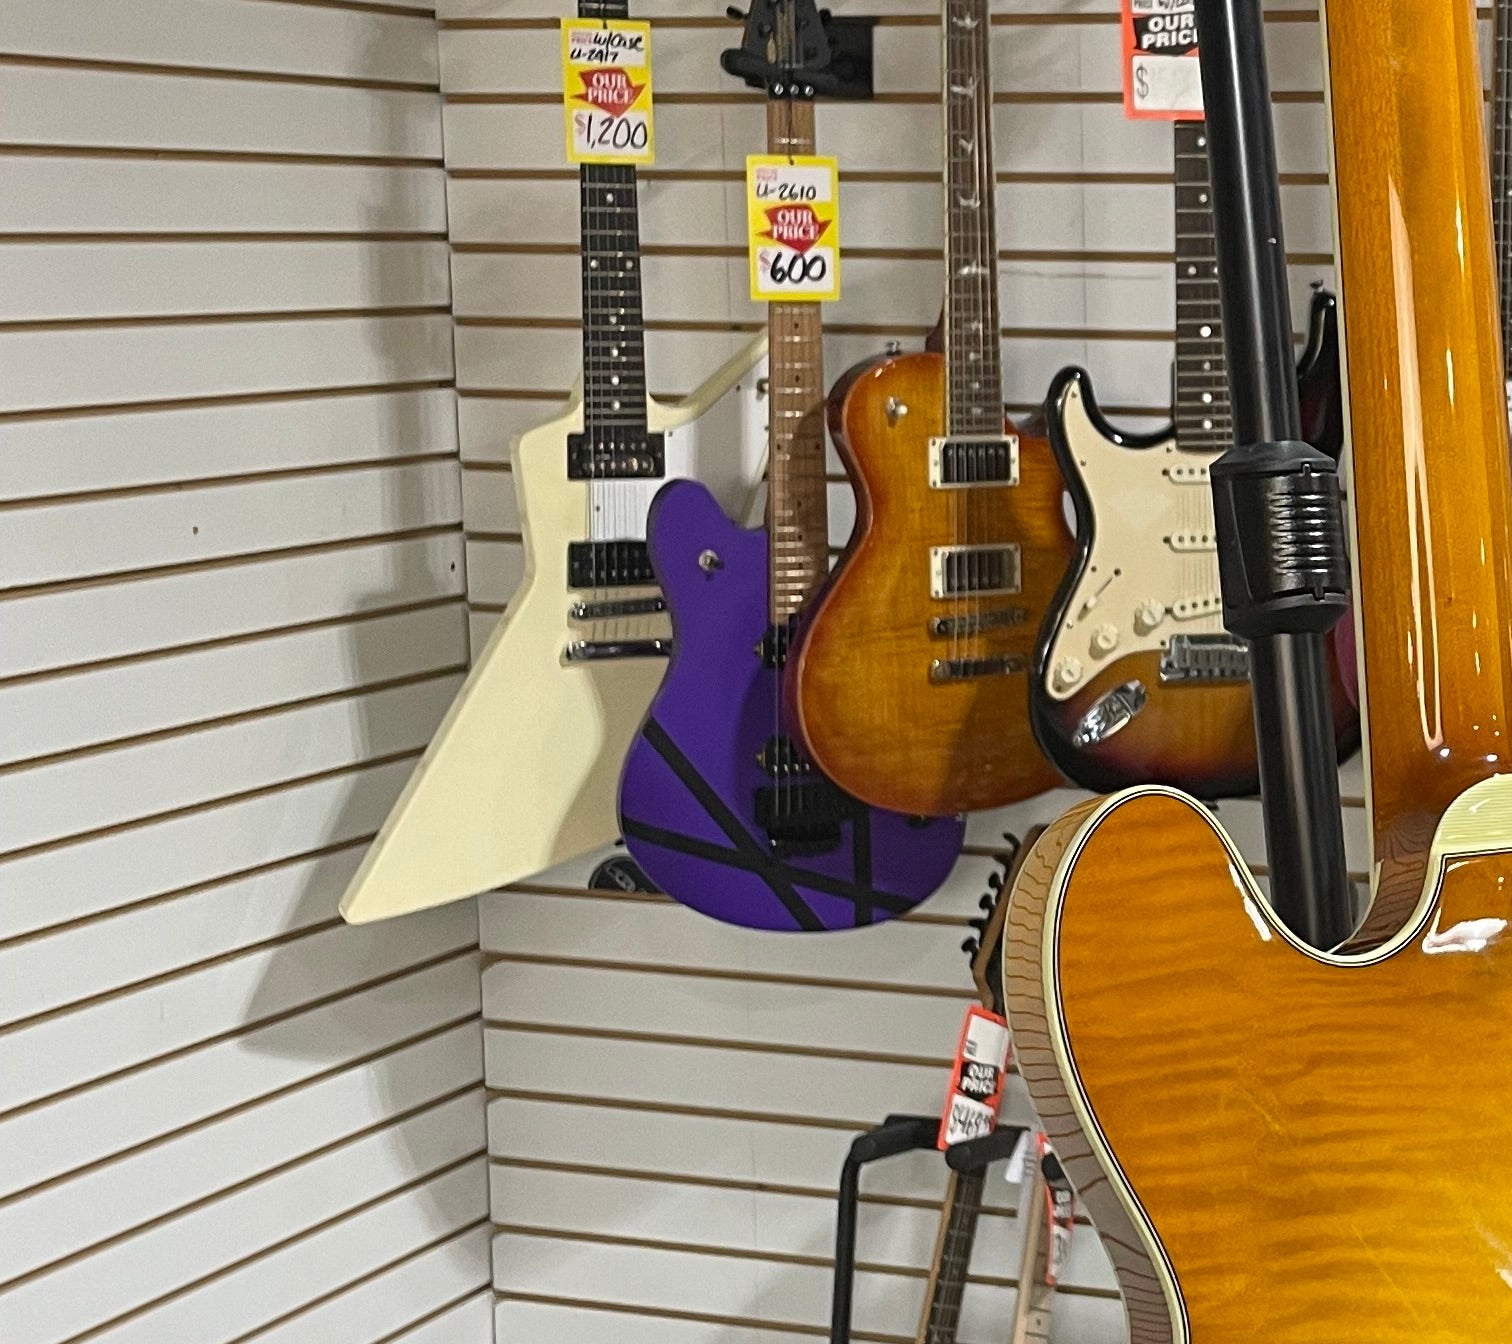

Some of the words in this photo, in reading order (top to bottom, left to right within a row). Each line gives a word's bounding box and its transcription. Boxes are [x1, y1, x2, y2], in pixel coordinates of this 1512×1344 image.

[1148, 13, 1195, 33] OUR
[591, 72, 628, 89] OUR
[587, 87, 633, 105] PRICE
[574, 113, 648, 150] $1,200
[777, 208, 813, 225] OUR
[772, 223, 820, 241] PRICE
[758, 249, 827, 284] $600
